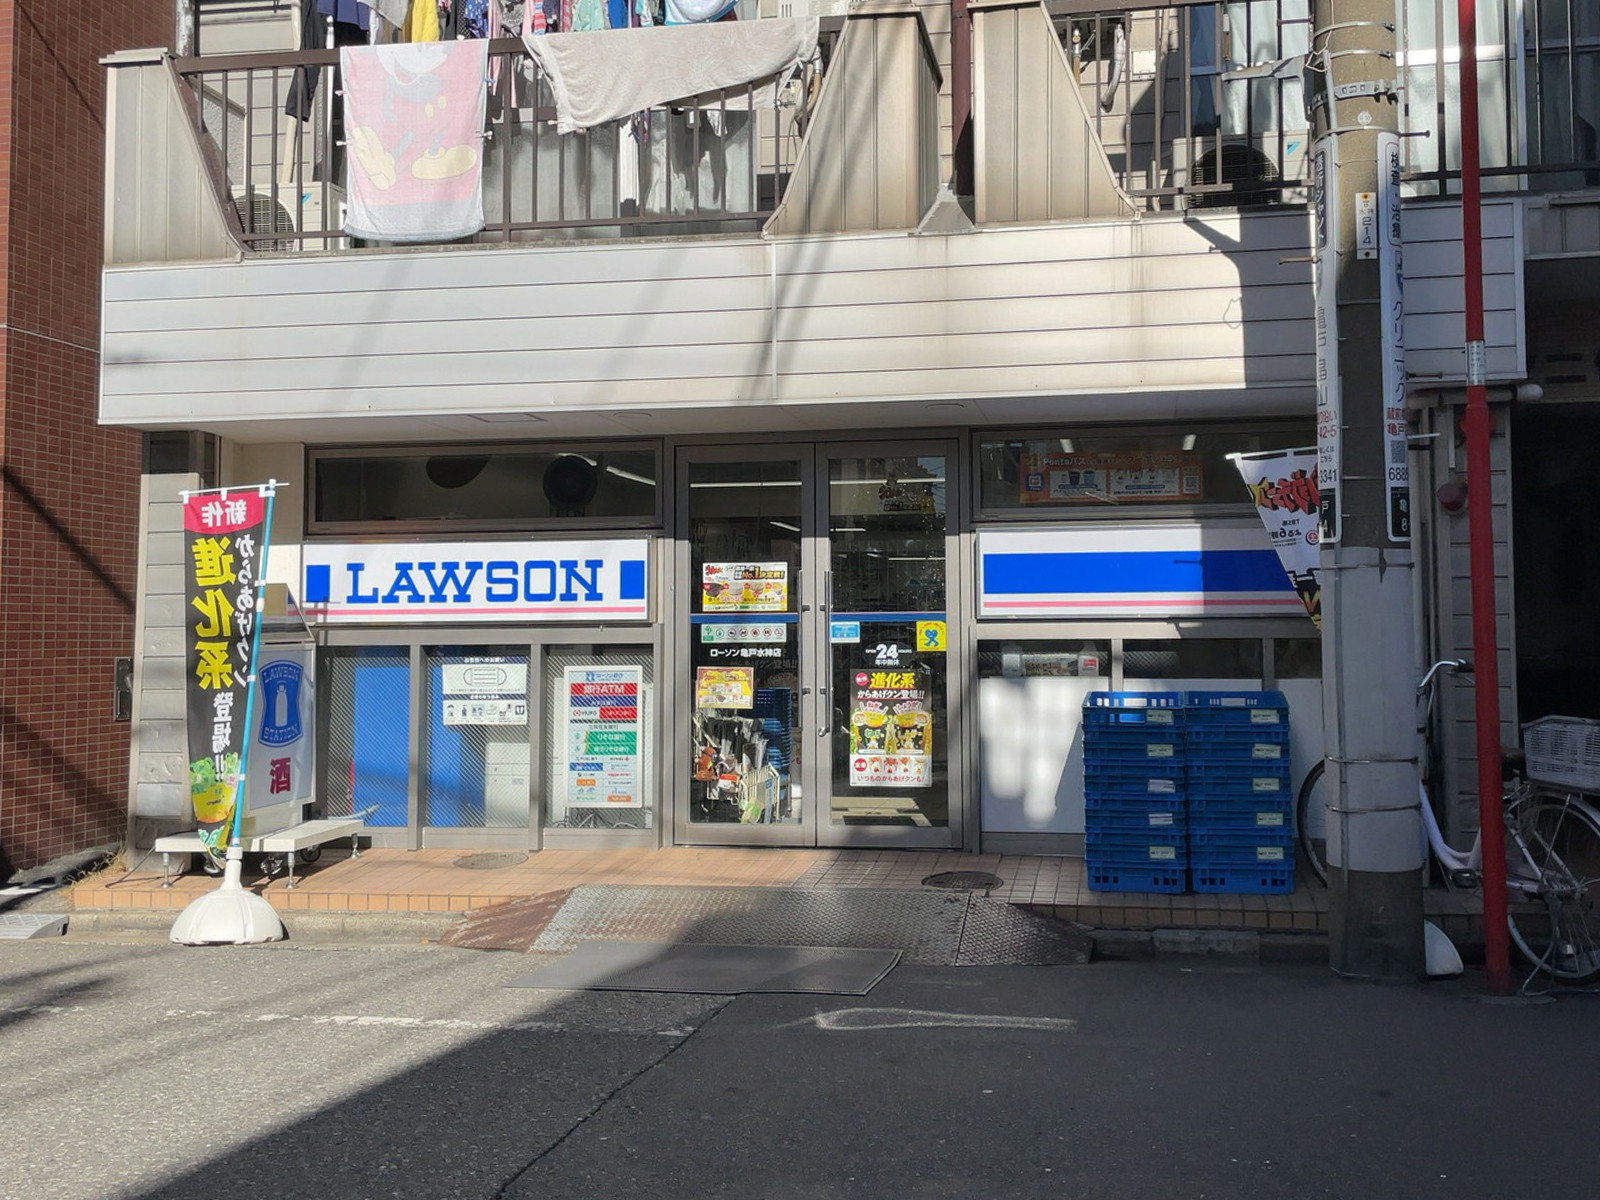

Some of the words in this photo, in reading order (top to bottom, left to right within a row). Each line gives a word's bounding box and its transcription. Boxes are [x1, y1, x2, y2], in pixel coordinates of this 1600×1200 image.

[1362, 216, 1372, 244] 214
[346, 559, 604, 604] LAWSON
[875, 643, 899, 660] 24
[263, 665, 300, 684] LAWSON
[869, 672, 916, 689] 進化系
[269, 757, 291, 795] 酒
